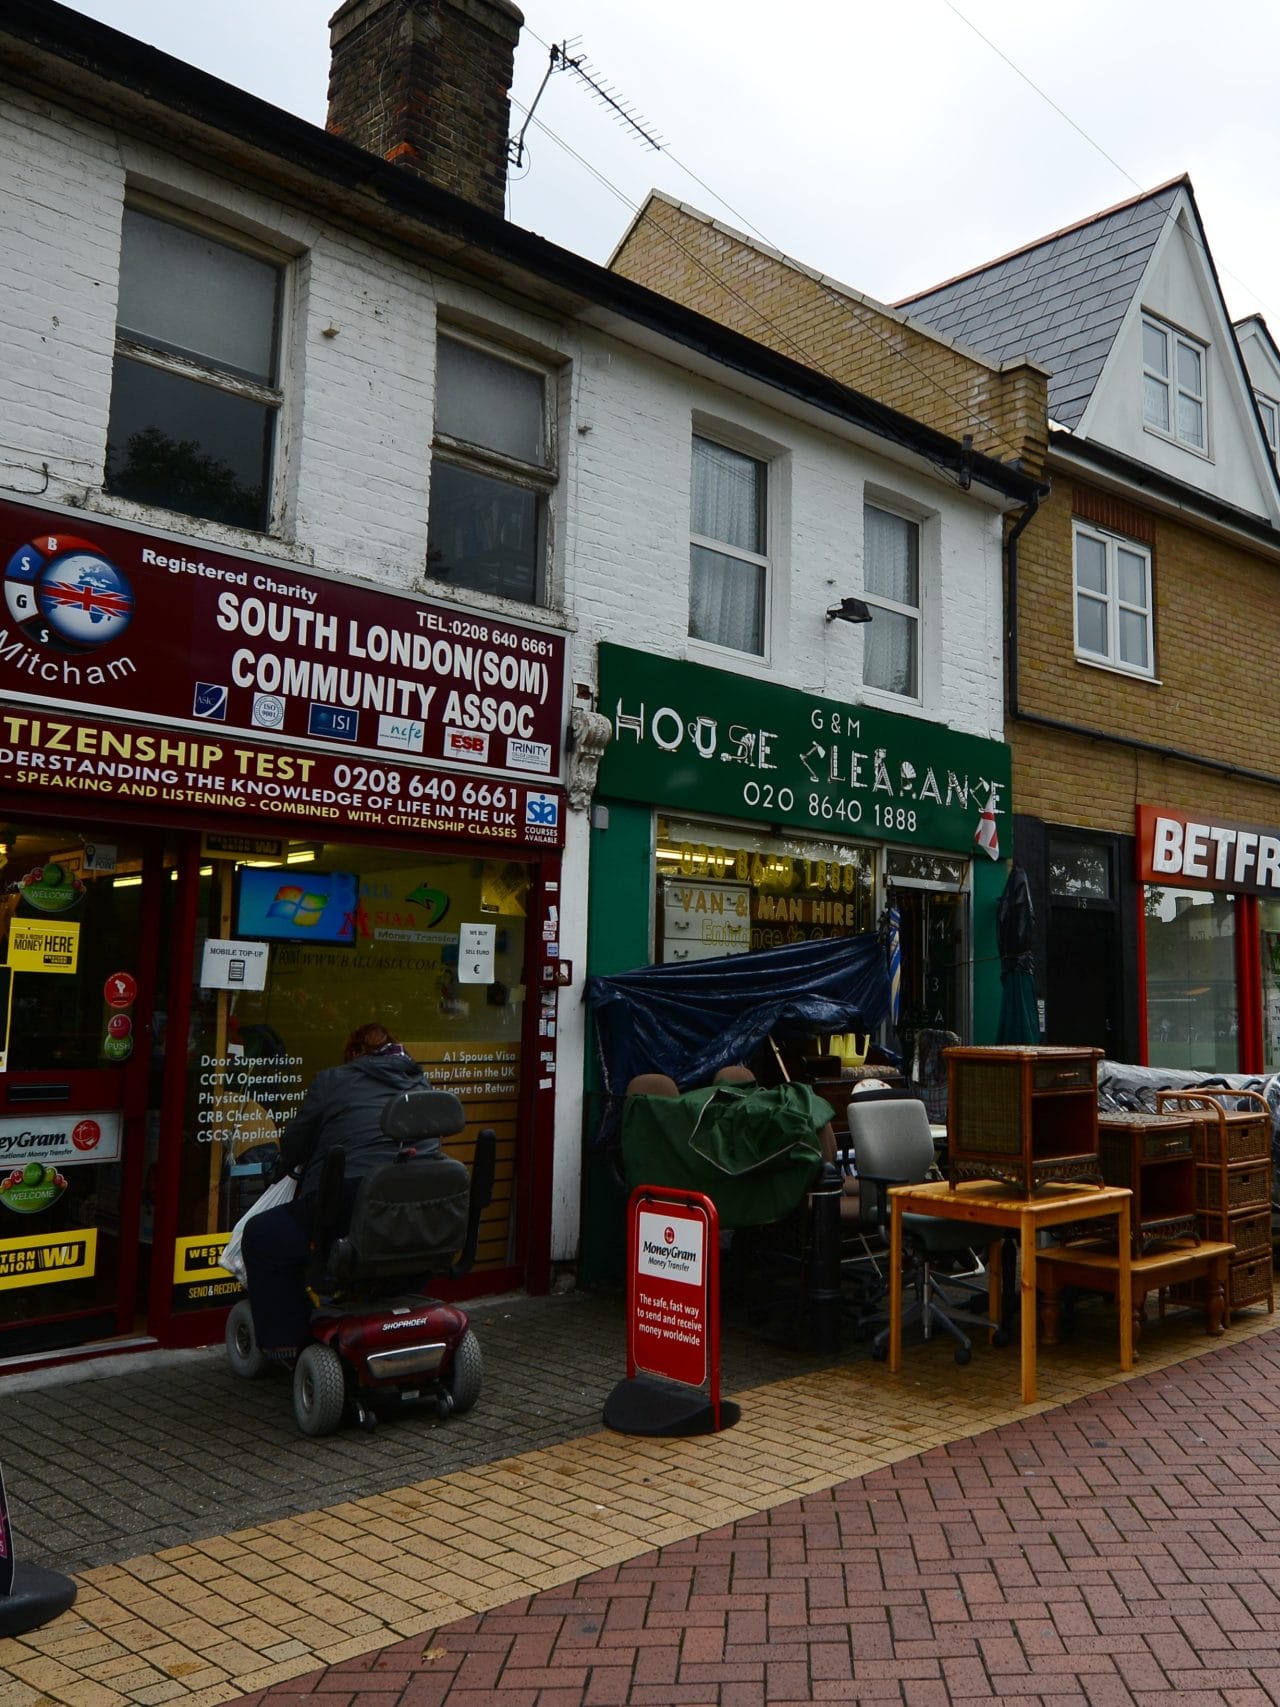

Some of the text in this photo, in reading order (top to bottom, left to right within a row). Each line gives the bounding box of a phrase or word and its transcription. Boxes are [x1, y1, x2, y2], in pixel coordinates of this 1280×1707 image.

[47, 536, 58, 551] B
[20, 556, 31, 571] S
[142, 548, 319, 604] Registered Charity
[16, 594, 27, 609] G
[40, 630, 50, 643] S
[416, 611, 554, 658] TEL:0208 640 6661
[0, 629, 137, 685] Mitcham
[216, 592, 549, 705] SOUTH LONDON(SOM)
[231, 649, 535, 739] COMMUNITY ASSOC
[332, 713, 350, 731] ISI
[810, 709, 861, 739] G & M
[615, 697, 779, 769] HOUSE
[450, 733, 485, 752] ESB
[510, 741, 549, 757] TRINITY
[3, 716, 517, 810] TIZENSHIP TEST 0208 640 6661
[0, 749, 516, 826] DERSTANDING THE KNOWLEDGE OF LIFE IN THE UK
[17, 770, 113, 793] SPEAKING
[117, 782, 158, 797] AND
[162, 787, 247, 808] LISTENING
[259, 799, 340, 821] COMBINED
[388, 814, 465, 833] CITIZENSHIP
[468, 823, 518, 839] CLASSES
[743, 781, 918, 833] 020 8640 1888
[524, 826, 558, 838] COURSES
[524, 834, 558, 845] AVAILABLE
[803, 858, 856, 895] 1888
[31, 889, 75, 900] WELCOME
[680, 887, 856, 927] VAN & MAN HIRE
[14, 938, 44, 952] MONEY
[44, 935, 74, 953] HERE
[210, 947, 264, 957] MOBILE TOP-UP
[107, 1043, 131, 1051] PUSH
[200, 1054, 303, 1068] Door Supervision
[443, 1050, 517, 1064] A1 Spouse Visa
[199, 1071, 303, 1087] CCTV Operations
[423, 1067, 515, 1081] nship/Life in the UK
[473, 1084, 482, 1094] to
[484, 1082, 515, 1094] Return
[198, 1091, 250, 1106] Physical
[197, 1107, 298, 1124] CRB Check Appli
[196, 1126, 286, 1143] CSCS Applicat
[28, 1150, 48, 1160] Money
[49, 1149, 73, 1157] Transfer
[10, 1189, 56, 1201] WELCOME
[43, 1244, 79, 1268] WU
[189, 1246, 225, 1258] WEST
[643, 1240, 697, 1262] MoneyGram
[648, 1256, 690, 1273] Money Transfer
[639, 1293, 700, 1319] The safe, fast way
[381, 1317, 429, 1332] SHOPRIDER
[637, 1307, 702, 1332] to send and receive
[639, 1322, 701, 1346] money worldwide
